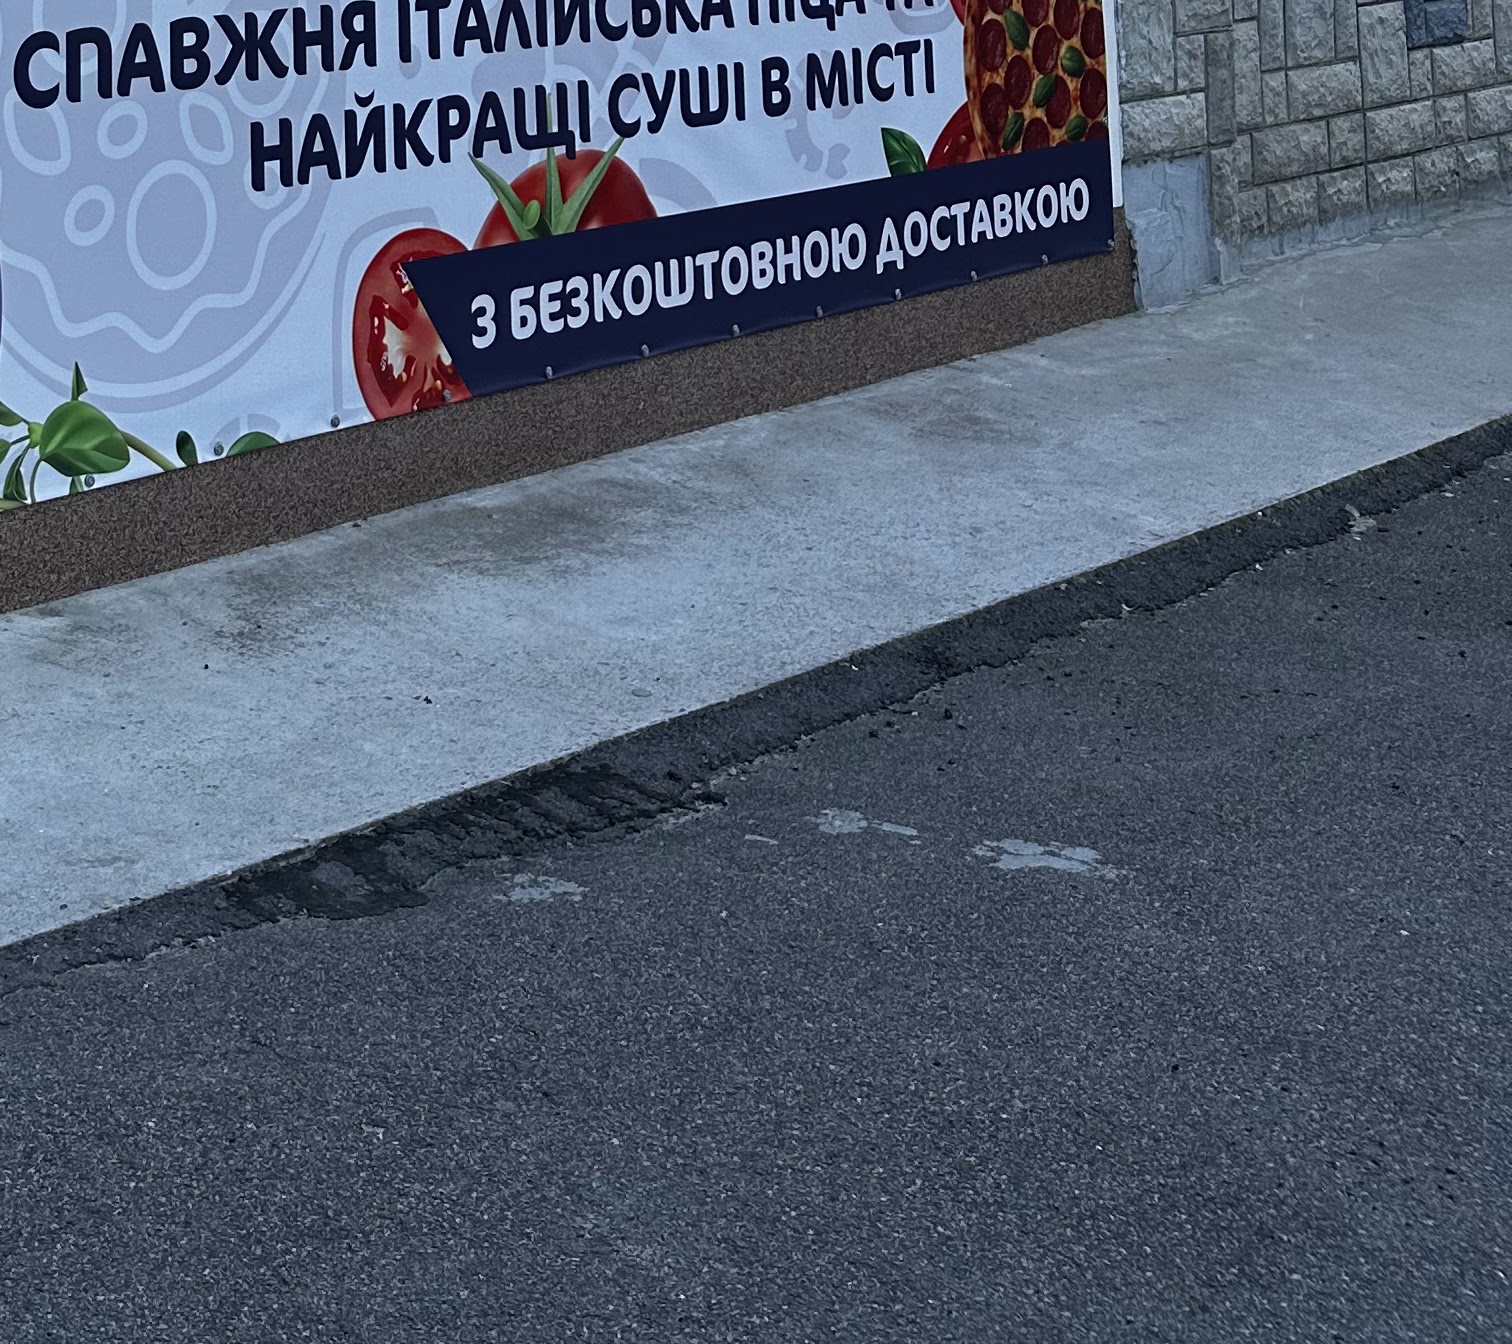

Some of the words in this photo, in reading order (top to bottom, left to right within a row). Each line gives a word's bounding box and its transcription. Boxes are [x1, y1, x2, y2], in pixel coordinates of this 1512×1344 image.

[13, 0, 378, 110] СПАВЖНЯ
[249, 79, 592, 192] НАЙКРАЩІ
[607, 61, 747, 139] СУШІ
[760, 56, 790, 118] В
[805, 38, 936, 112] МІСТІ
[470, 293, 497, 350] З
[510, 223, 868, 341] БЕЗКОШТОВНОЮ
[875, 178, 1091, 275] ДОСТАВКОЮ
